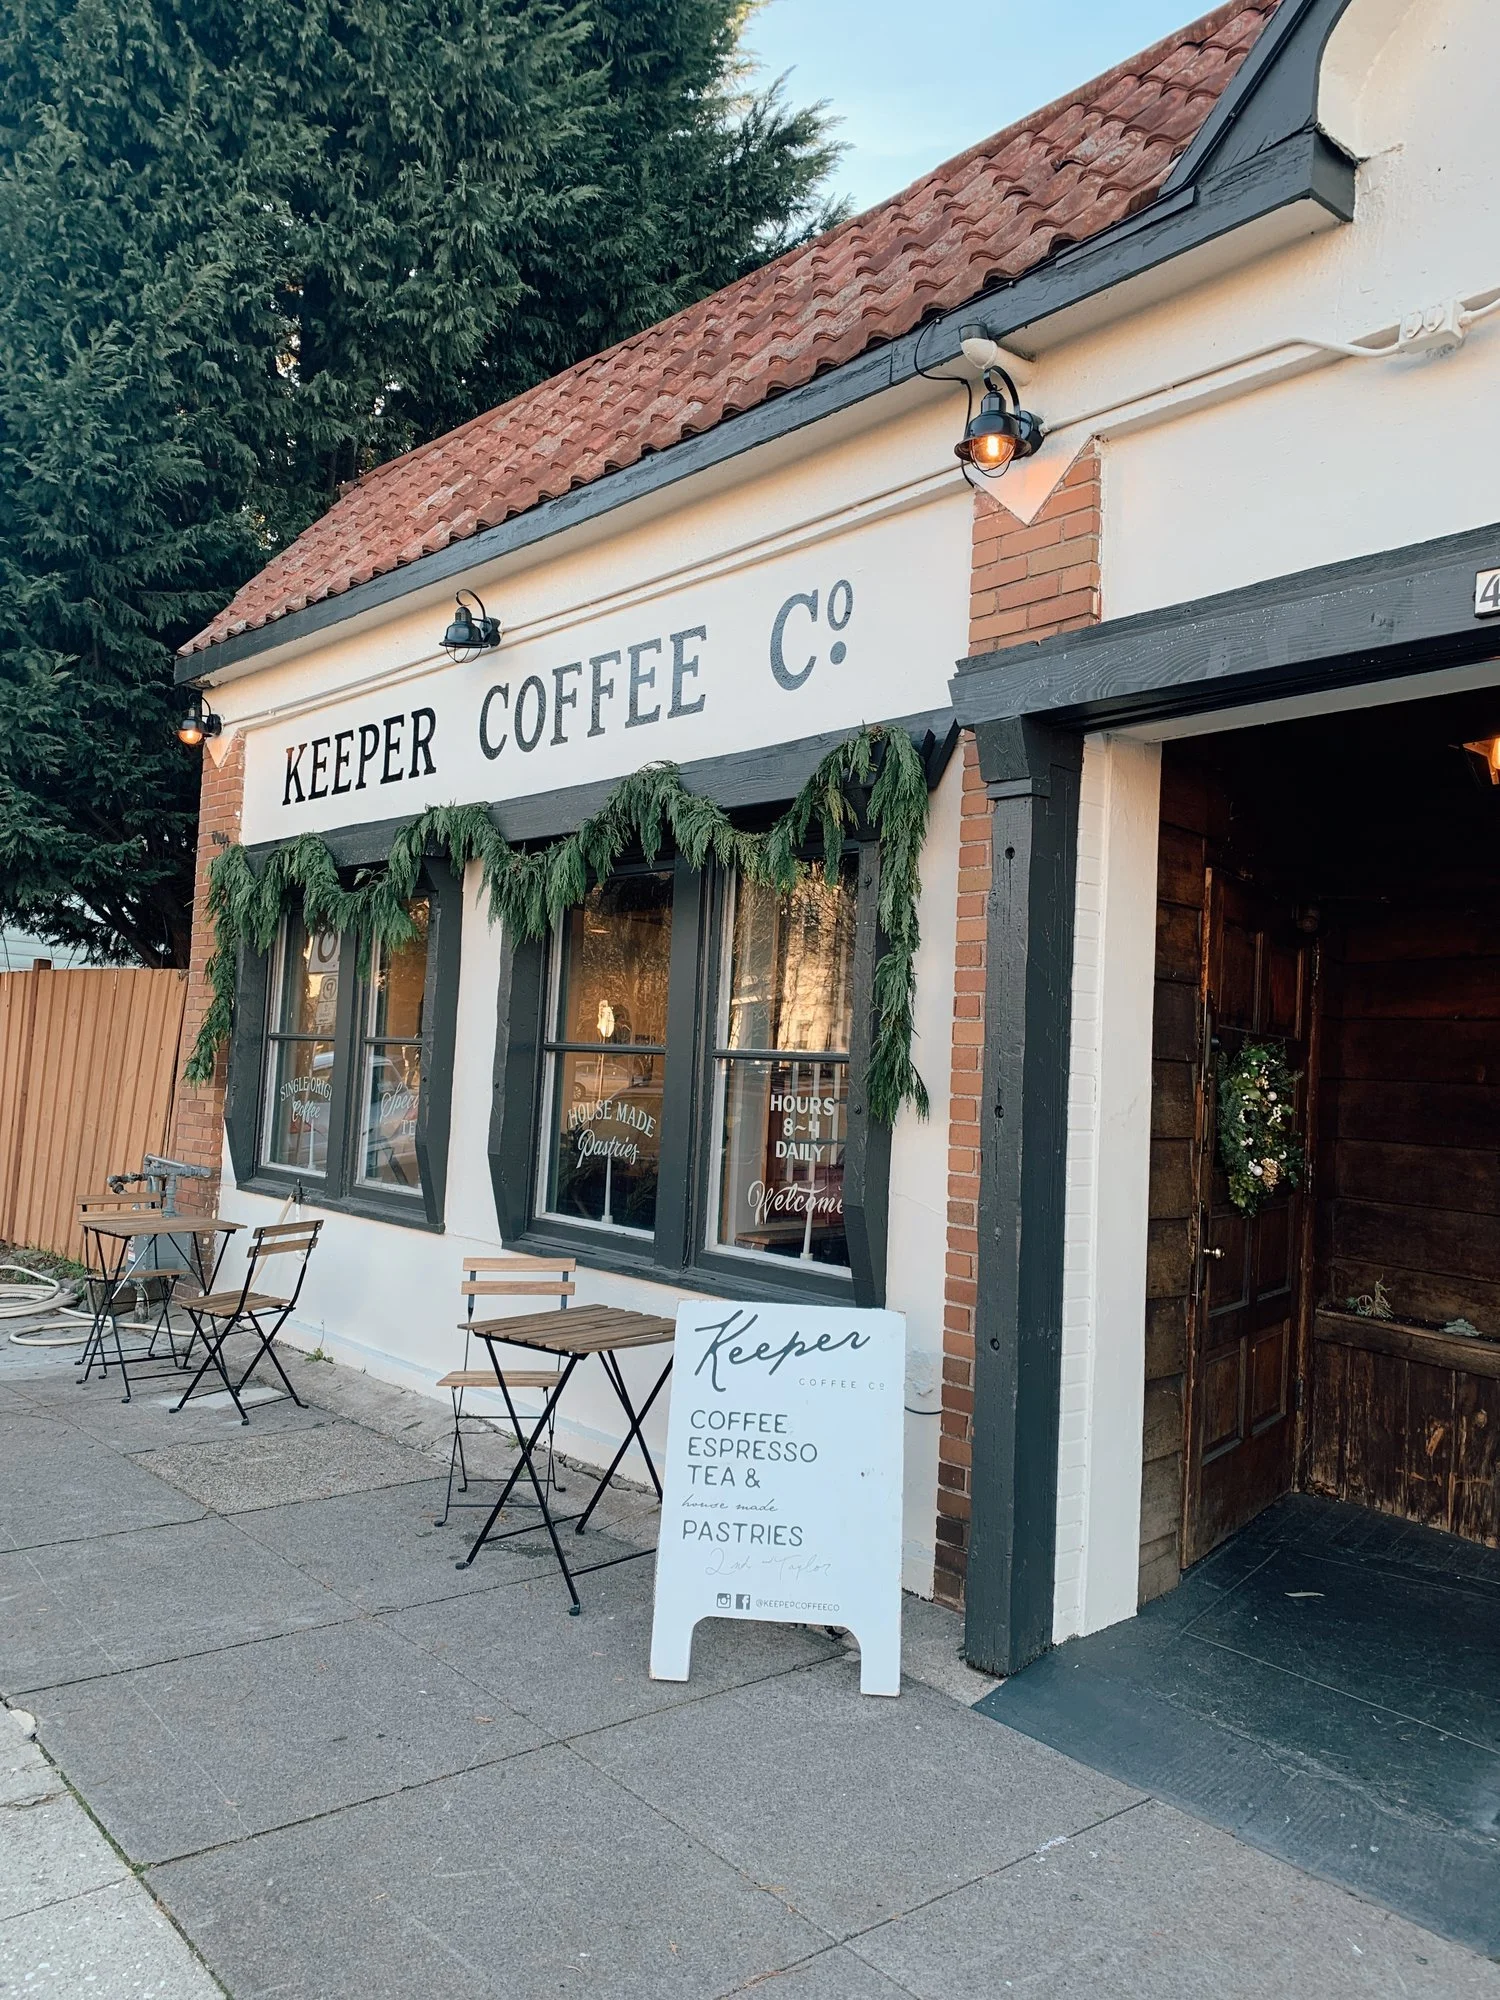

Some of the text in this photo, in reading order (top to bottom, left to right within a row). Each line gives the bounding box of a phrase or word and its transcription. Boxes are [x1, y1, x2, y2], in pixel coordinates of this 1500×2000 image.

[1480, 573, 1500, 608] 4
[282, 706, 437, 806] KEEPER
[478, 624, 707, 760] COFFEE
[280, 1076, 309, 1101] SINGLE
[292, 1099, 320, 1122] Coffee
[770, 1094, 835, 1117] HOURS
[568, 1099, 656, 1138] HOUSE MADE
[576, 1129, 640, 1169] Pastries
[775, 1140, 825, 1162] DAILY
[694, 1309, 871, 1393] Keeper
[799, 1378, 857, 1389] COFFEE
[690, 1409, 788, 1434] COFFEE
[688, 1437, 818, 1463] ESPRESSO
[687, 1465, 761, 1488] TEA &
[681, 1493, 779, 1512] house made
[682, 1519, 804, 1547] PASTRIES
